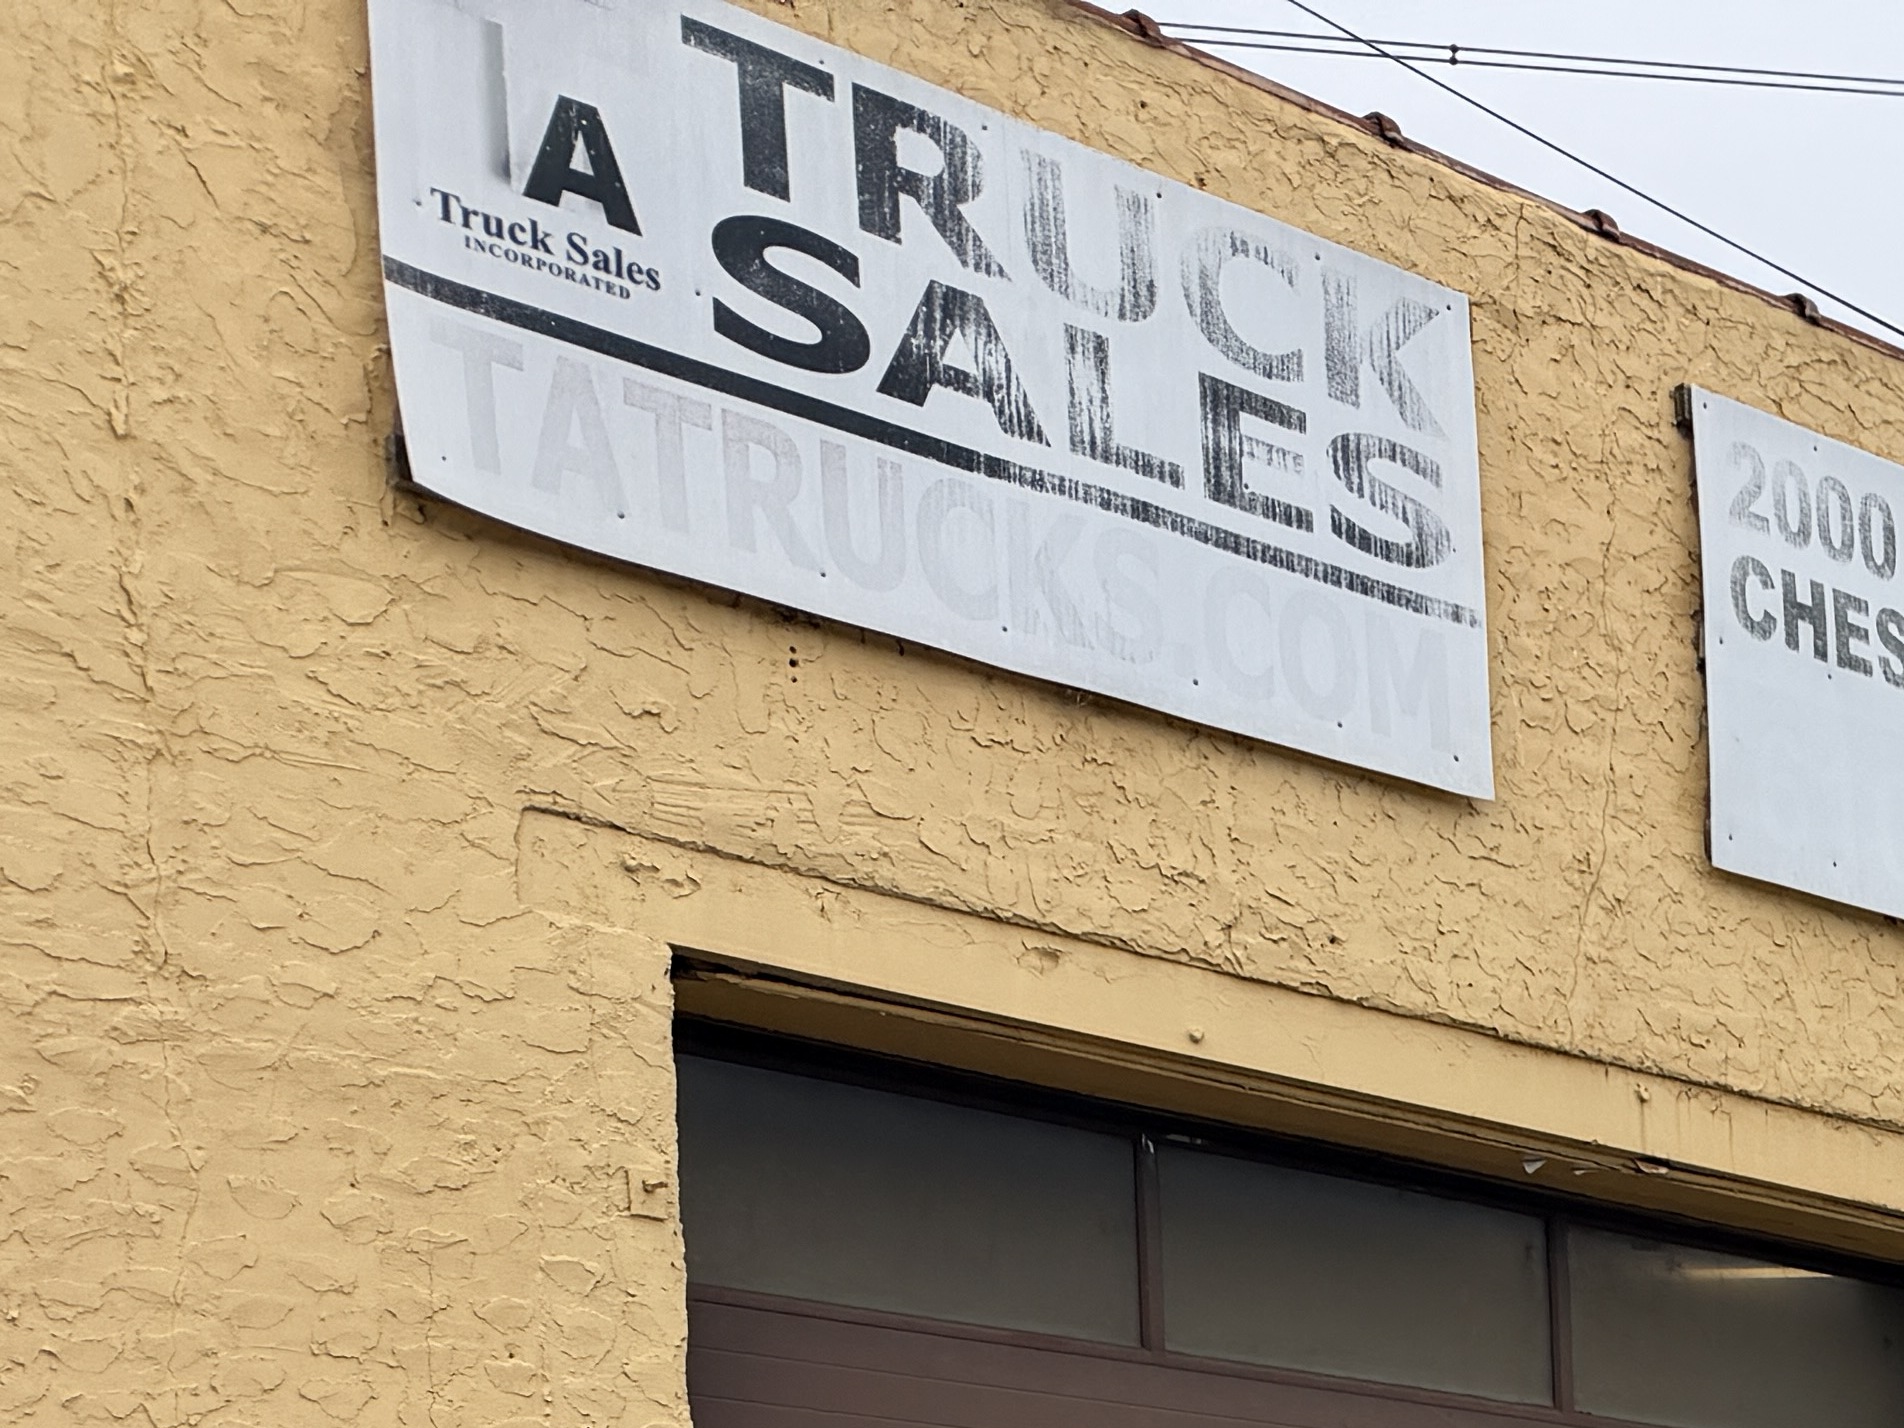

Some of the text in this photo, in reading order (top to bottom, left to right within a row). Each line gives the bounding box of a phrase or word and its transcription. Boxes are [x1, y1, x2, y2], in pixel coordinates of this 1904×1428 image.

[430, 187, 661, 291] Truck Sales
[464, 236, 631, 300] INCORPORATED
[680, 14, 1446, 439] TRUCK
[710, 214, 1457, 570] SALES
[1729, 441, 1898, 582] 2000
[430, 314, 1454, 755] TATRUCKS.COM
